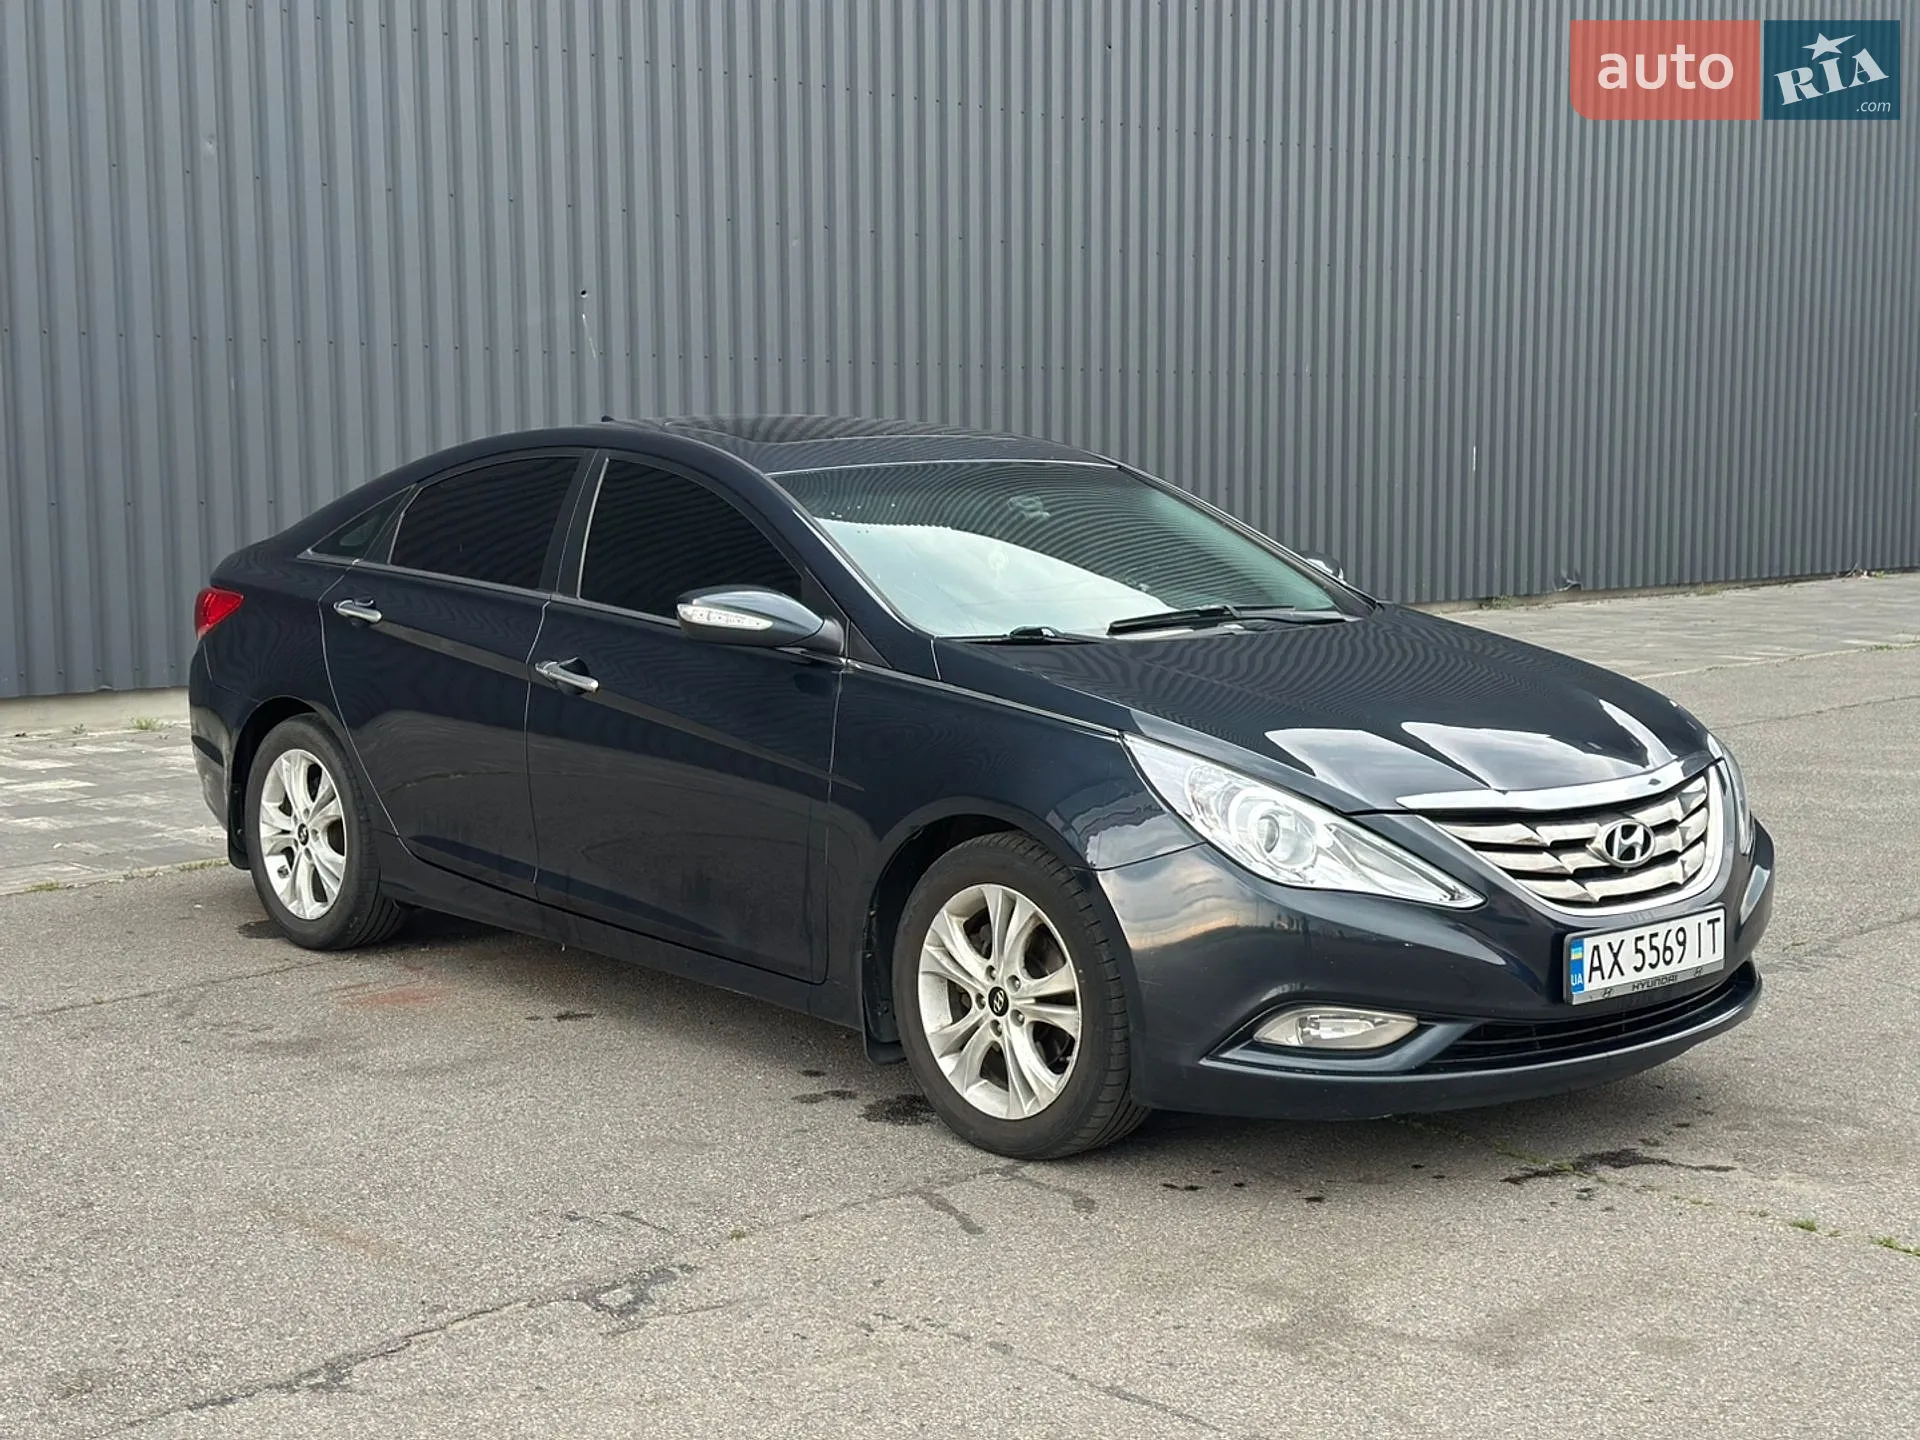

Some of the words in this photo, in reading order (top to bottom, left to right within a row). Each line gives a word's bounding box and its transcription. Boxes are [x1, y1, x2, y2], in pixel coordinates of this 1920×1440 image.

[1588, 939, 1625, 983] AX
[1633, 926, 1687, 973] 5569
[1697, 917, 1721, 959] IT
[1571, 973, 1584, 986] UA
[1632, 975, 1678, 991] HYUNDAI
